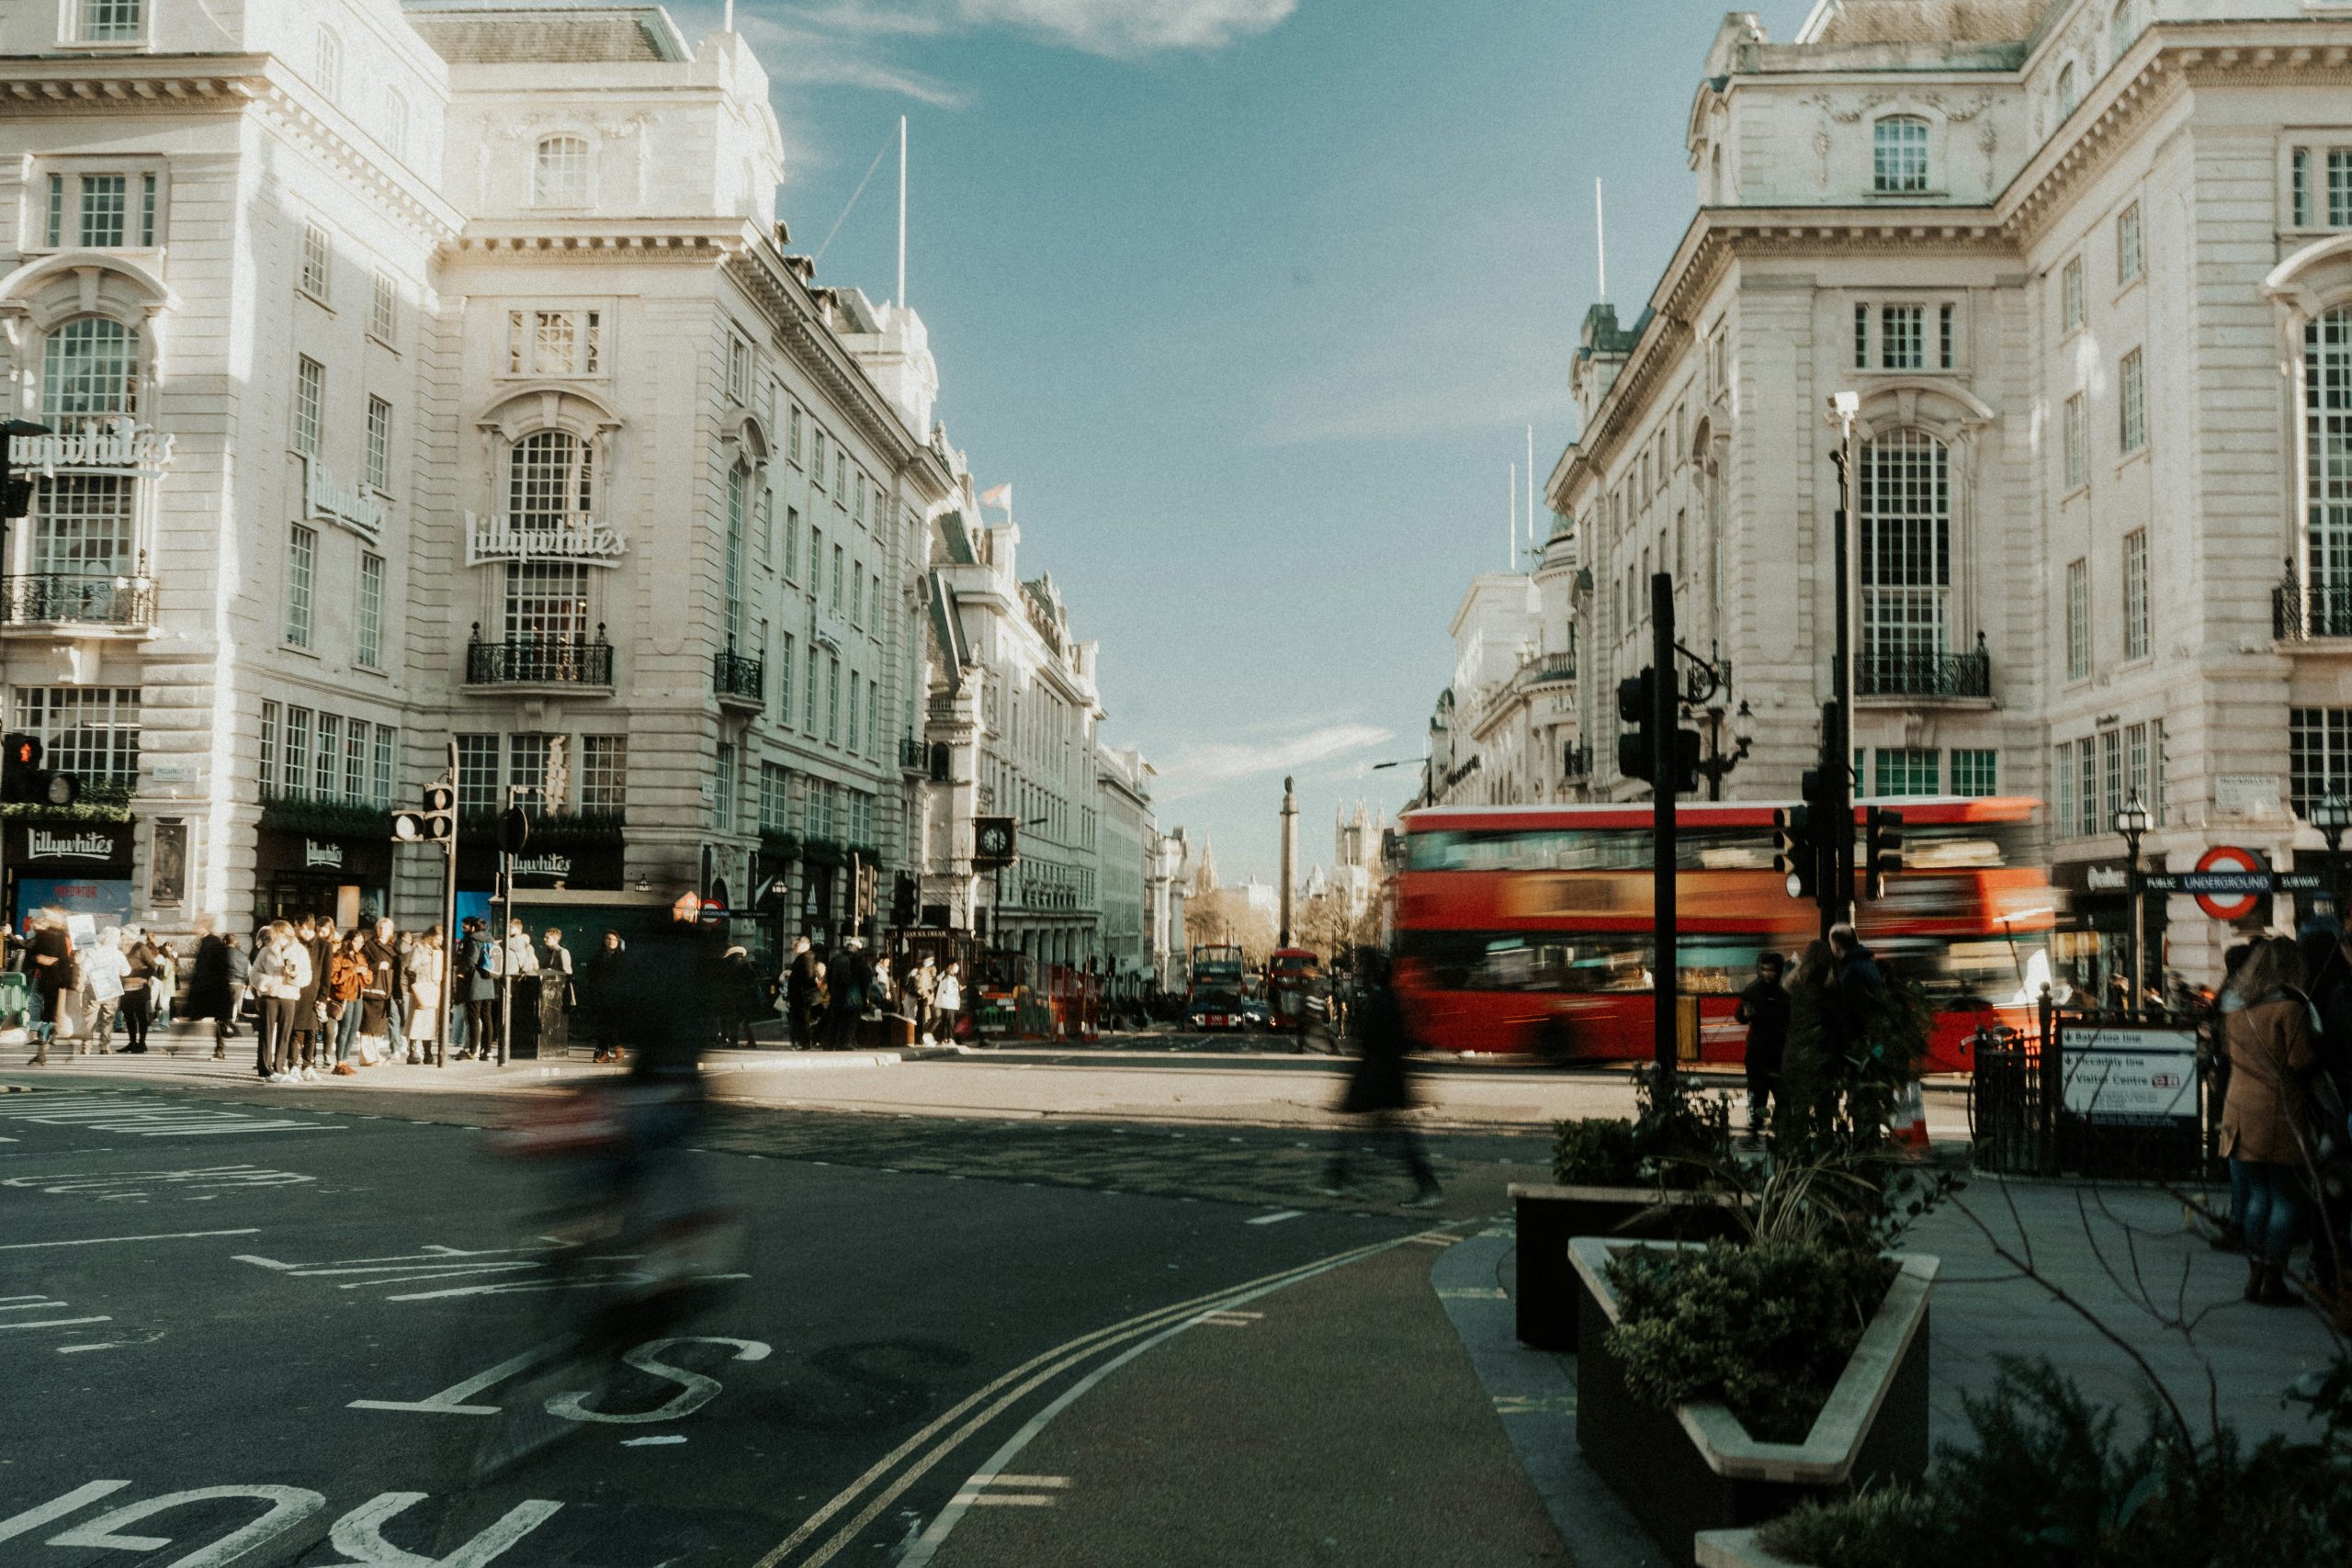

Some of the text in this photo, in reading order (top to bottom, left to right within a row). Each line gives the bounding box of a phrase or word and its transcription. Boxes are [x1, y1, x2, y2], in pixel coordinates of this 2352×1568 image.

[8, 415, 179, 479] llywhites
[308, 449, 386, 545] Lillywhites
[465, 508, 631, 569] Lillywhites
[28, 828, 114, 861] Lillywhites
[306, 837, 344, 868] Lillywhites
[499, 851, 572, 877] Lllywhites
[2146, 874, 2321, 890] PUBLIC UNDERGROUND SUBWAY
[701, 909, 730, 918] ERGROUND
[894, 930, 916, 938] ILIAN
[2112, 1075, 2148, 1086] Centre
